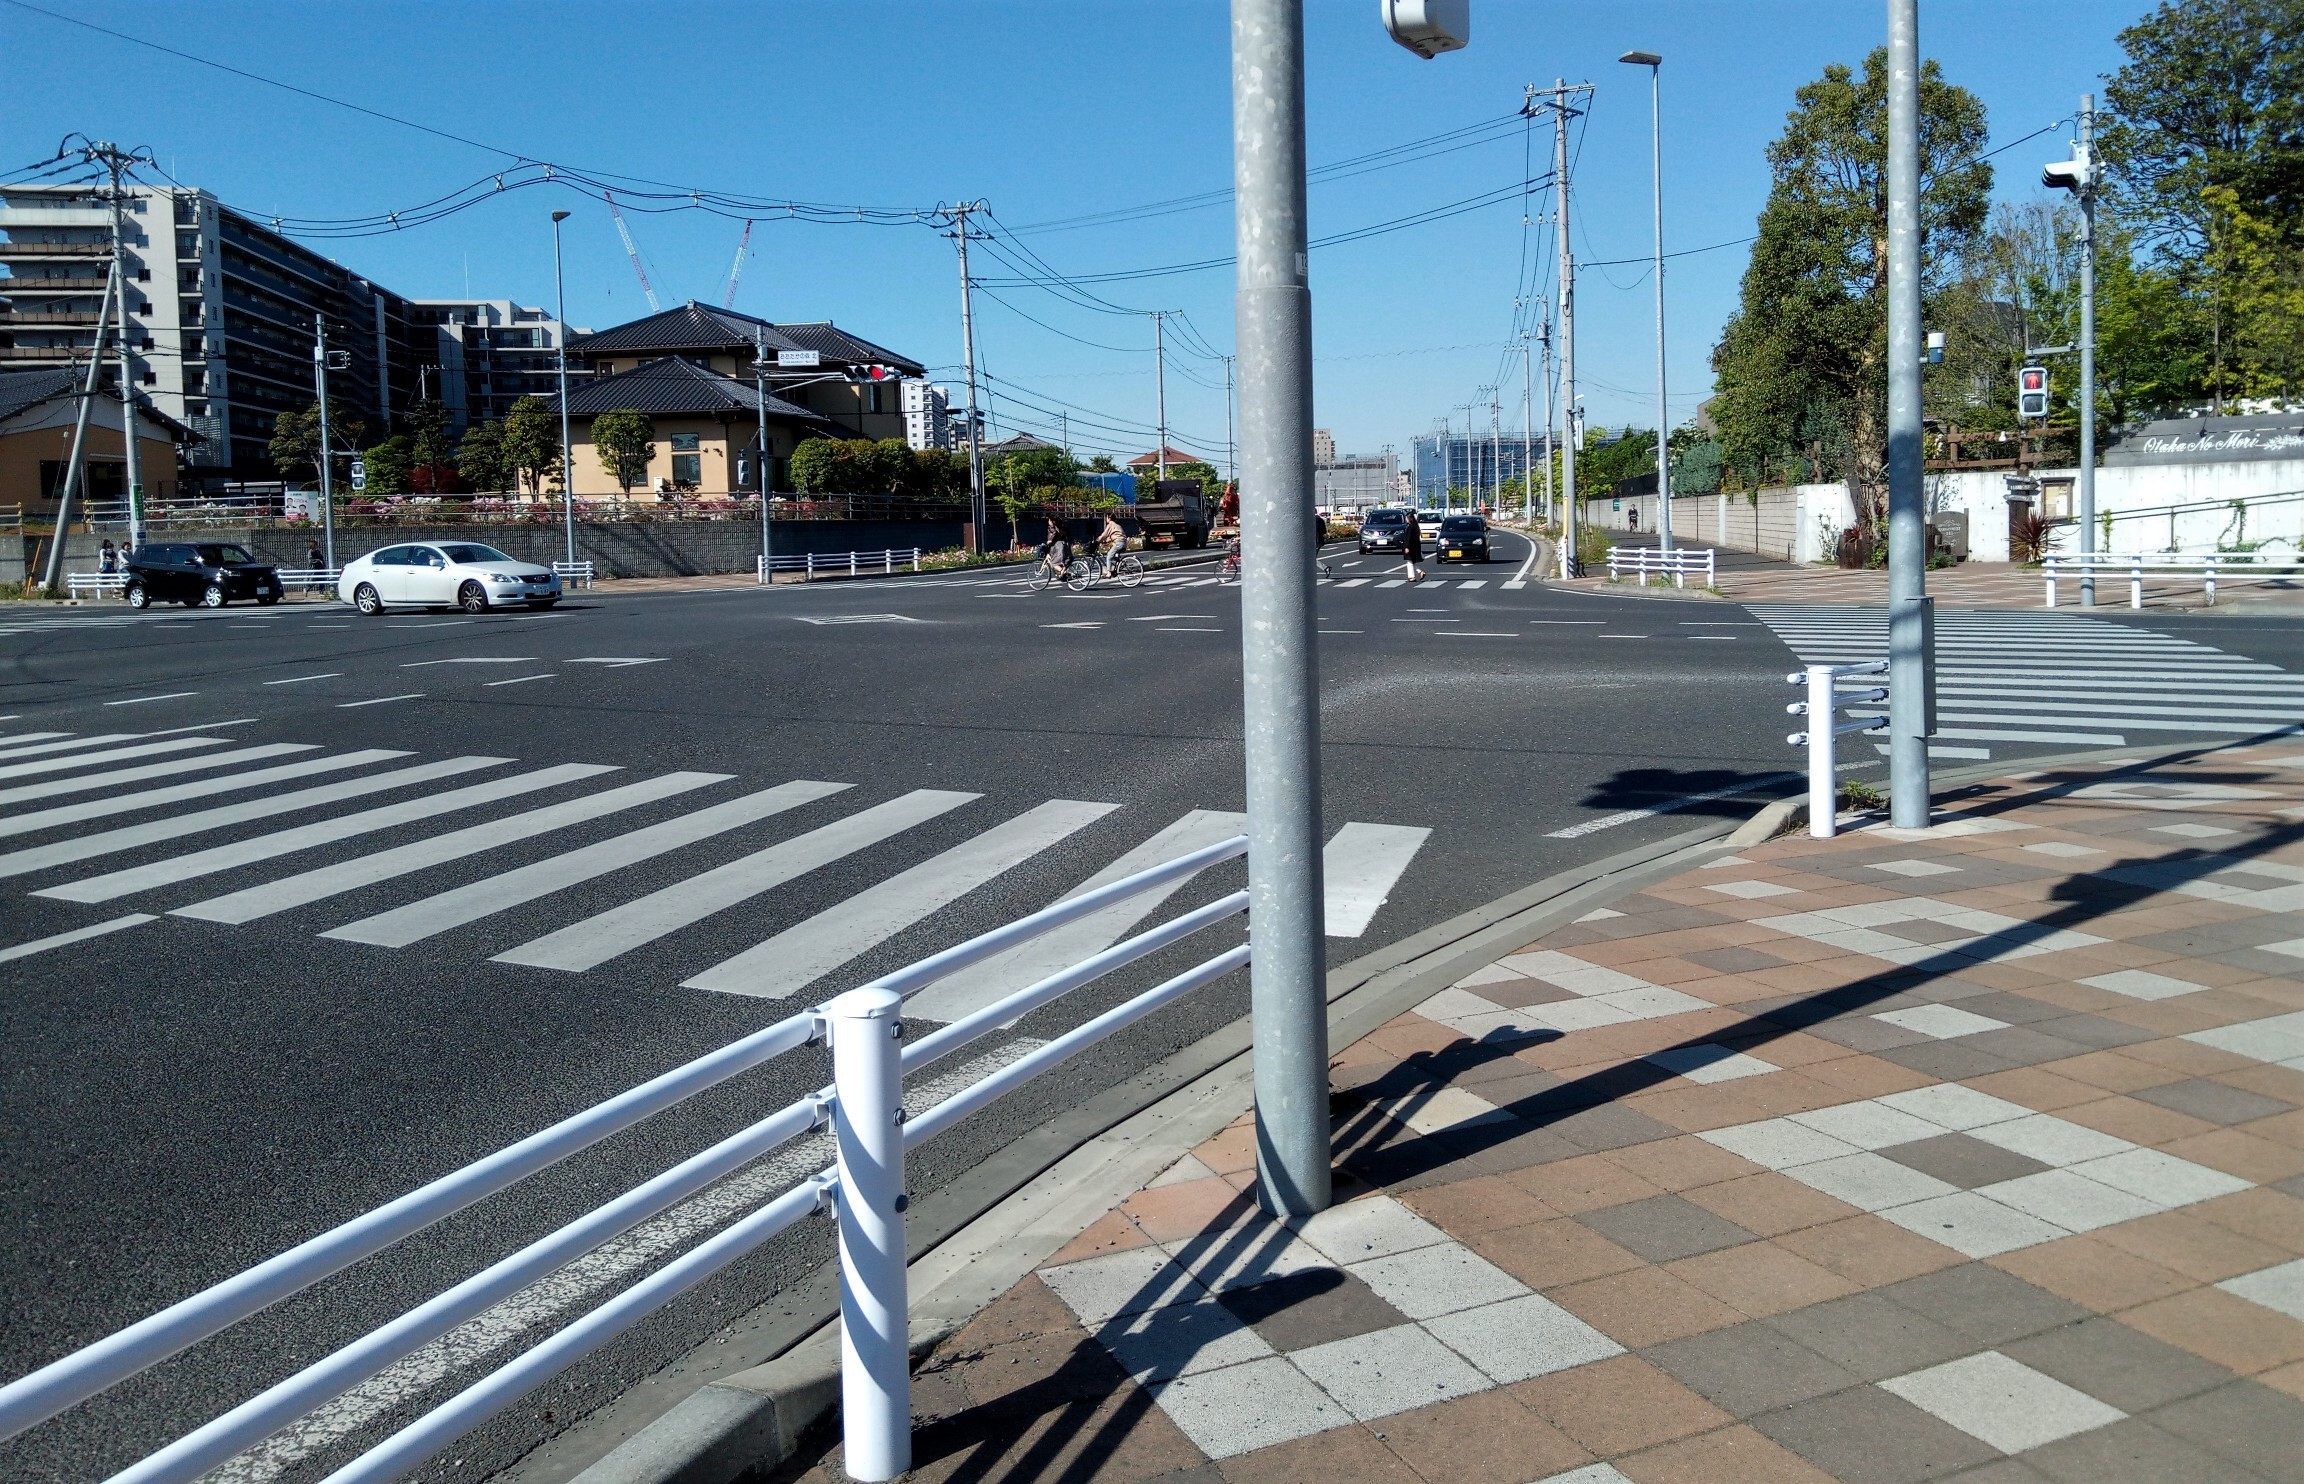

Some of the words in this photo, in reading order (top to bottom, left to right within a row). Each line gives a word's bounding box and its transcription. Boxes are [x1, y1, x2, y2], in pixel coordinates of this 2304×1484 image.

[2143, 436, 2187, 454] Otaka
[2187, 435, 2215, 451] No
[2215, 433, 2261, 450] Mori
